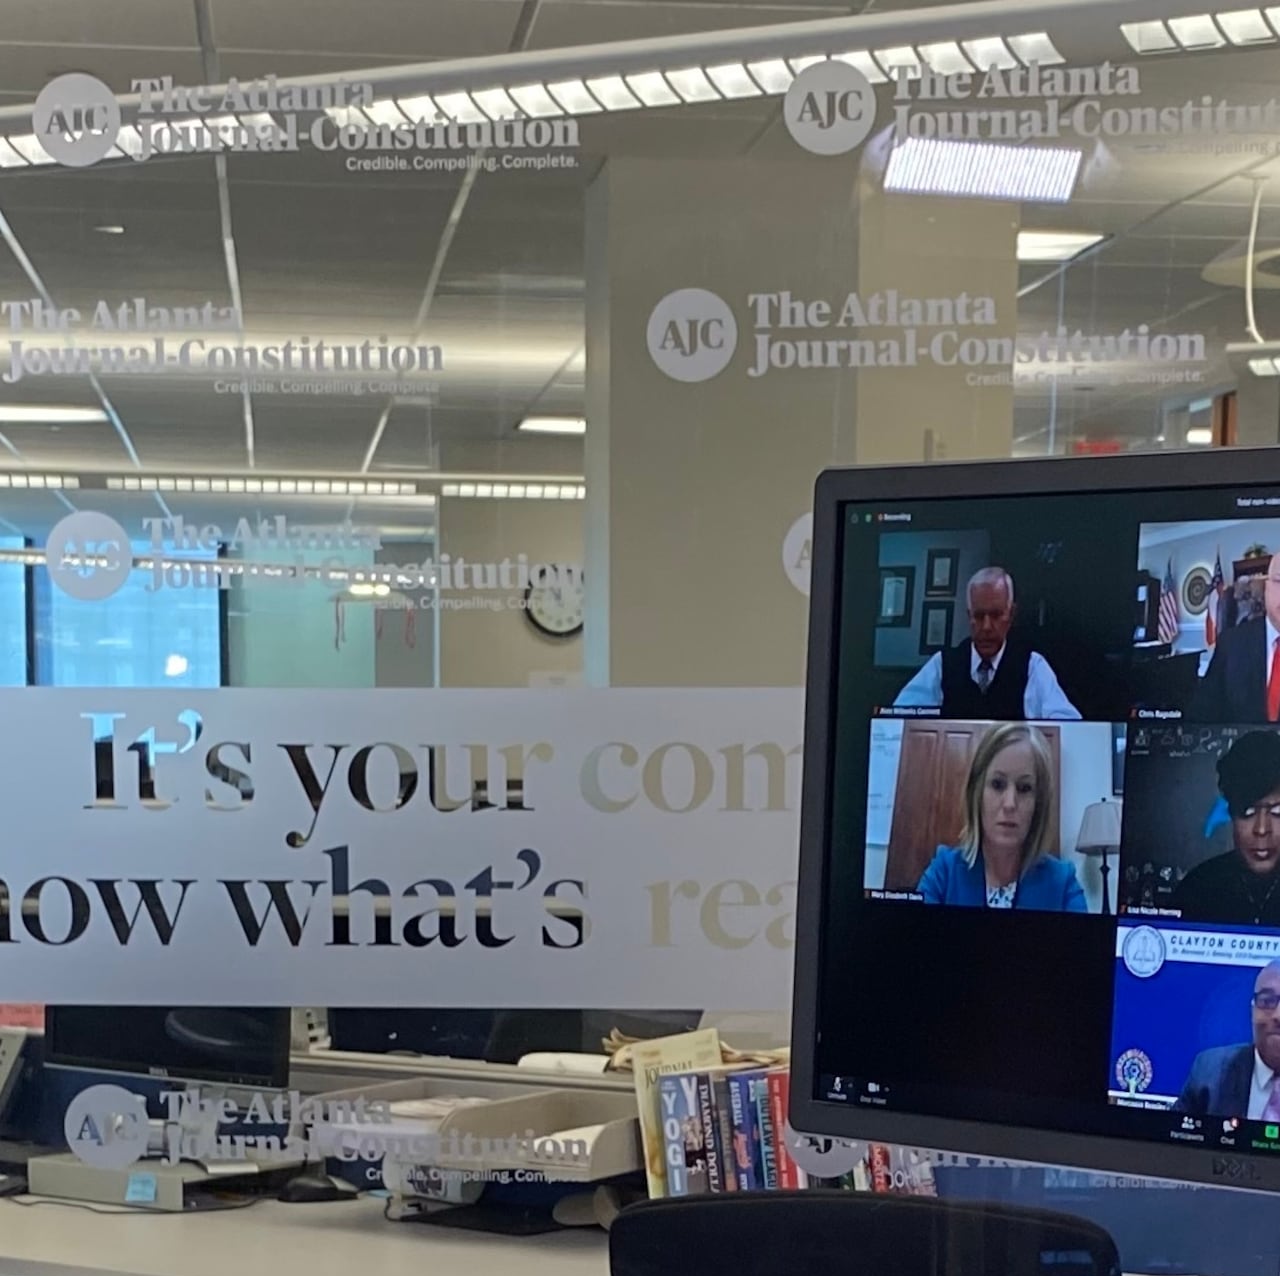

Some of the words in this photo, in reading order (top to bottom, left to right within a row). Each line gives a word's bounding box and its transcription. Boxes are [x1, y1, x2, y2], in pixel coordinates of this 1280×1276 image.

[132, 77, 211, 113] The
[220, 74, 374, 112] Atlanta
[890, 63, 972, 99] The
[979, 60, 1140, 99] Atlanta
[796, 89, 864, 128] AJC
[132, 110, 582, 161] Journal-Constitution
[345, 155, 411, 171] Credible.
[413, 154, 500, 173] Compelling.
[502, 153, 579, 170] Complete.
[1, 299, 81, 334] The
[91, 297, 239, 332] Atlanta
[748, 292, 830, 328] The
[838, 289, 997, 328] Atlanta
[659, 317, 725, 357] AJC
[748, 324, 1207, 377] Journal-Constitution
[1, 335, 444, 383] Journal-Constitution
[142, 516, 223, 551] The
[277, 740, 555, 848] your
[217, 843, 591, 950] what's
[1170, 934, 1225, 949] CLAYTON
[1231, 938, 1280, 952] COUNTY
[160, 1090, 239, 1124] The
[244, 1090, 393, 1126] Atlanta
